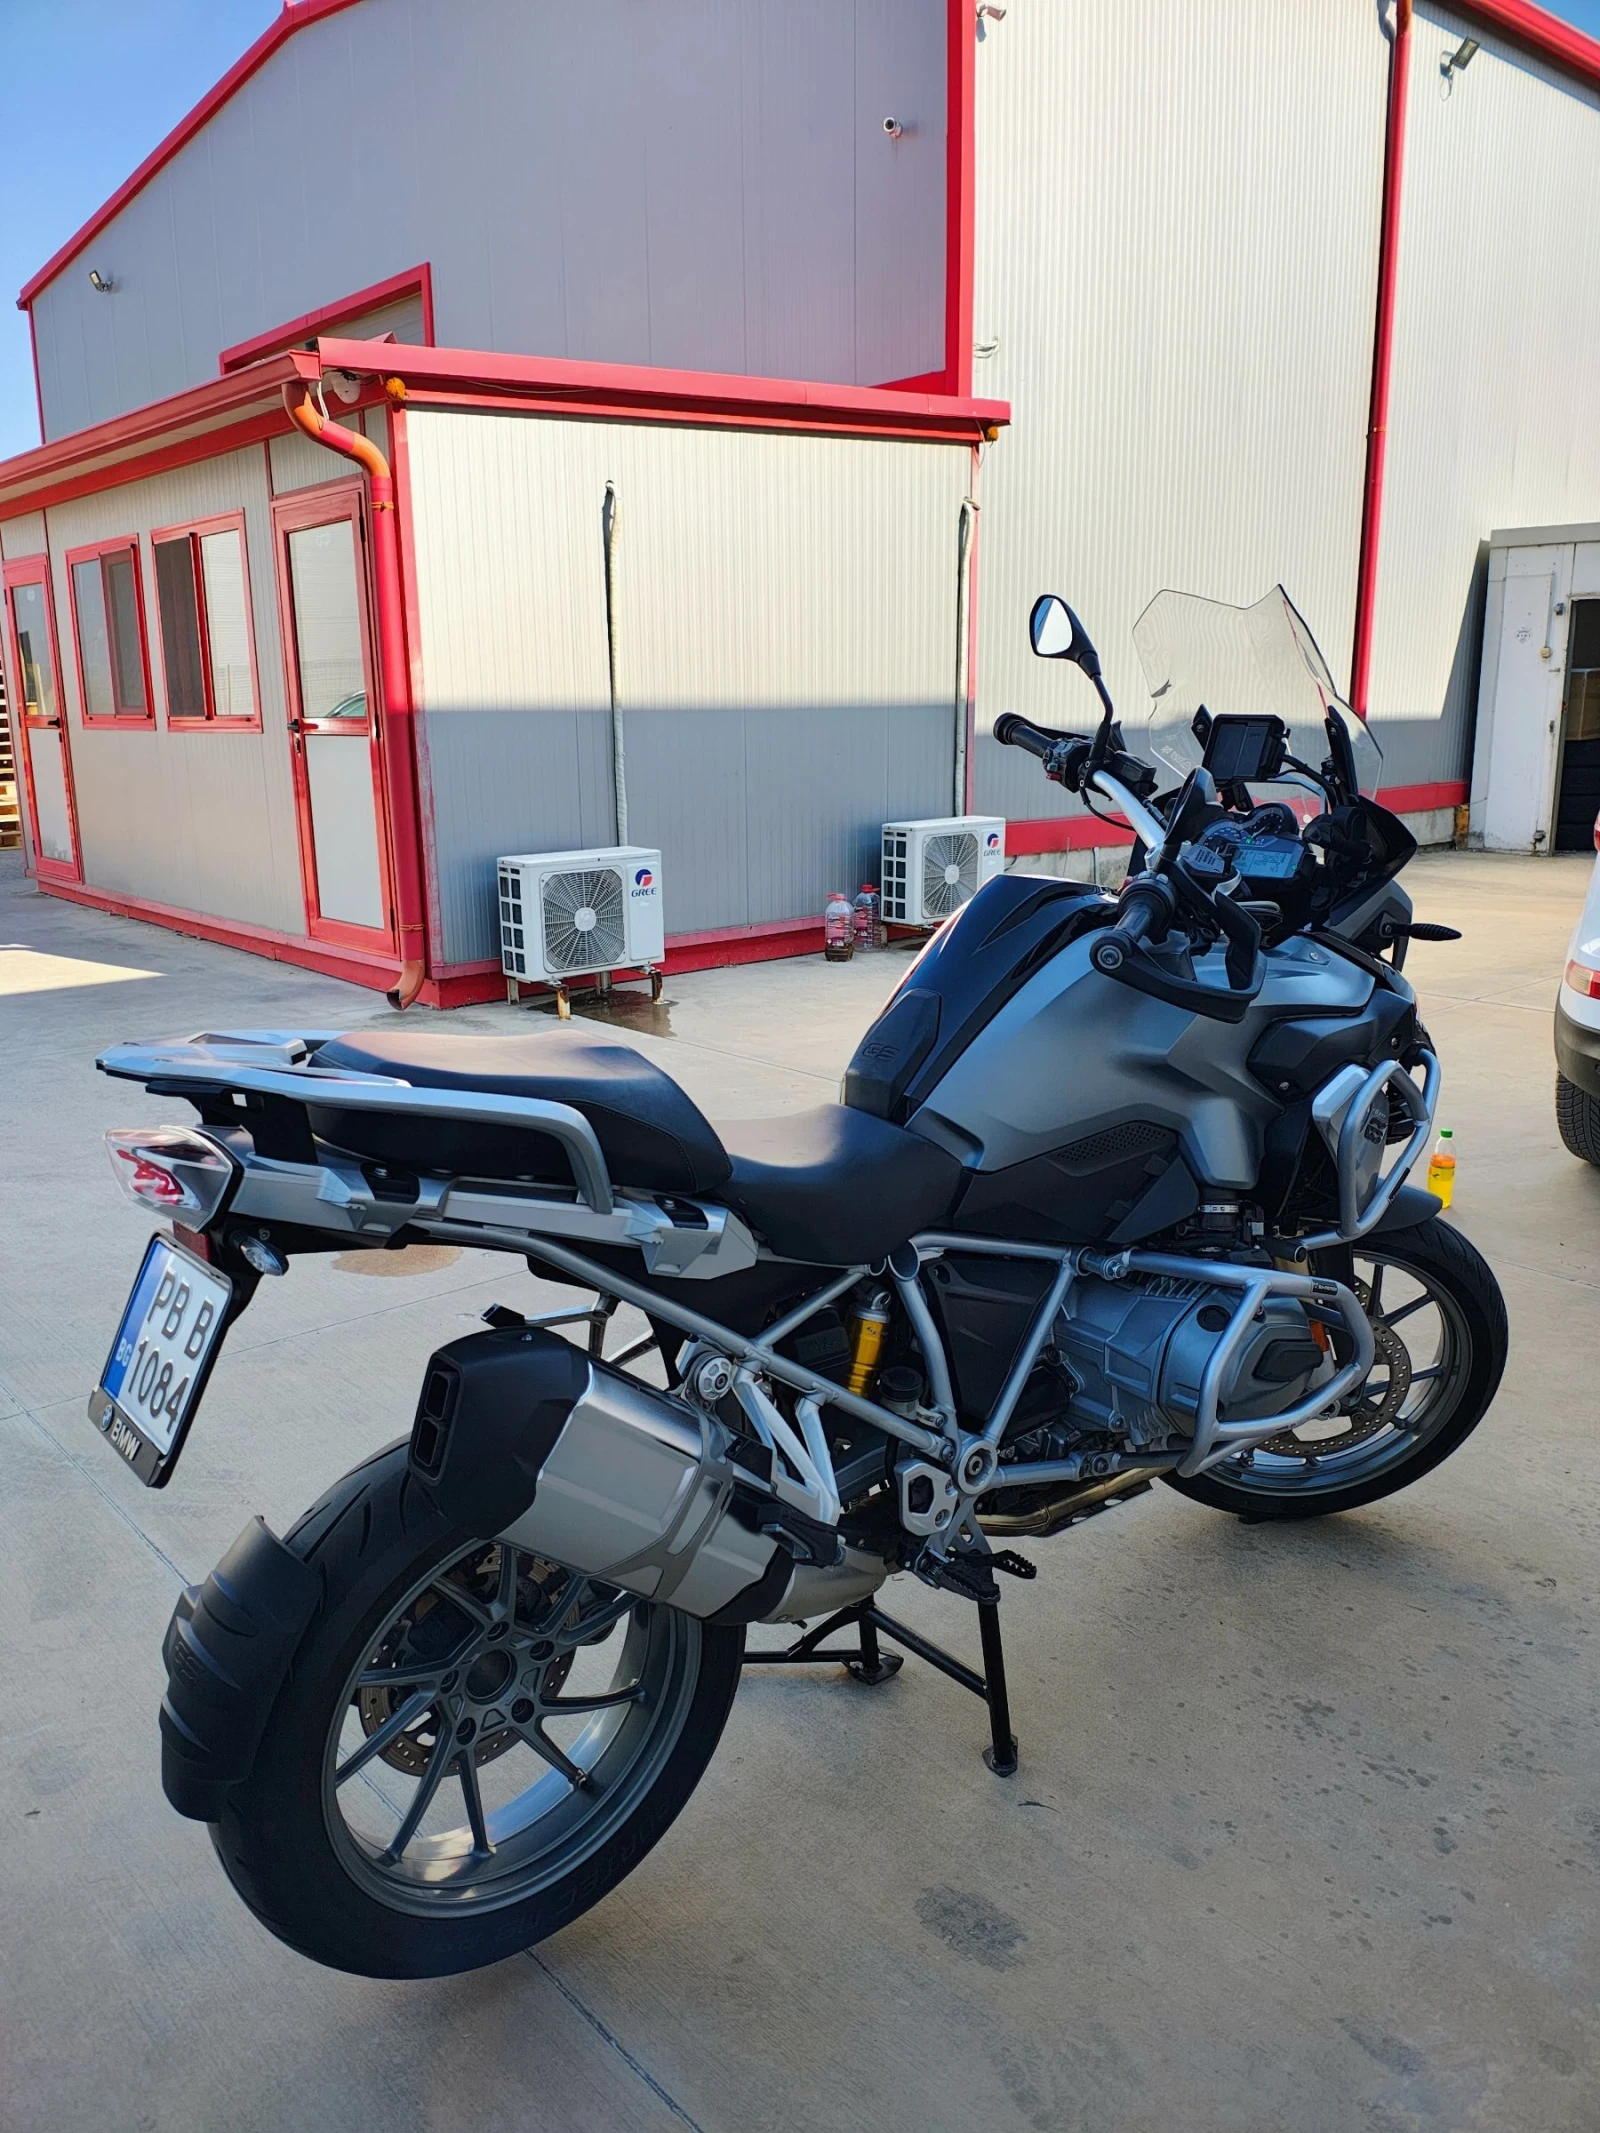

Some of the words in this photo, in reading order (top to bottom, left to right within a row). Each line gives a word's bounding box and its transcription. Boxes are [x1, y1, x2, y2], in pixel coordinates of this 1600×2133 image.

[983, 848, 1002, 857] GREE
[631, 887, 657, 898] GREE
[148, 1269, 191, 1341] PB
[184, 1297, 214, 1360] B
[116, 1338, 132, 1368] BG
[128, 1338, 190, 1434] 1084
[110, 1418, 141, 1461] BMW
